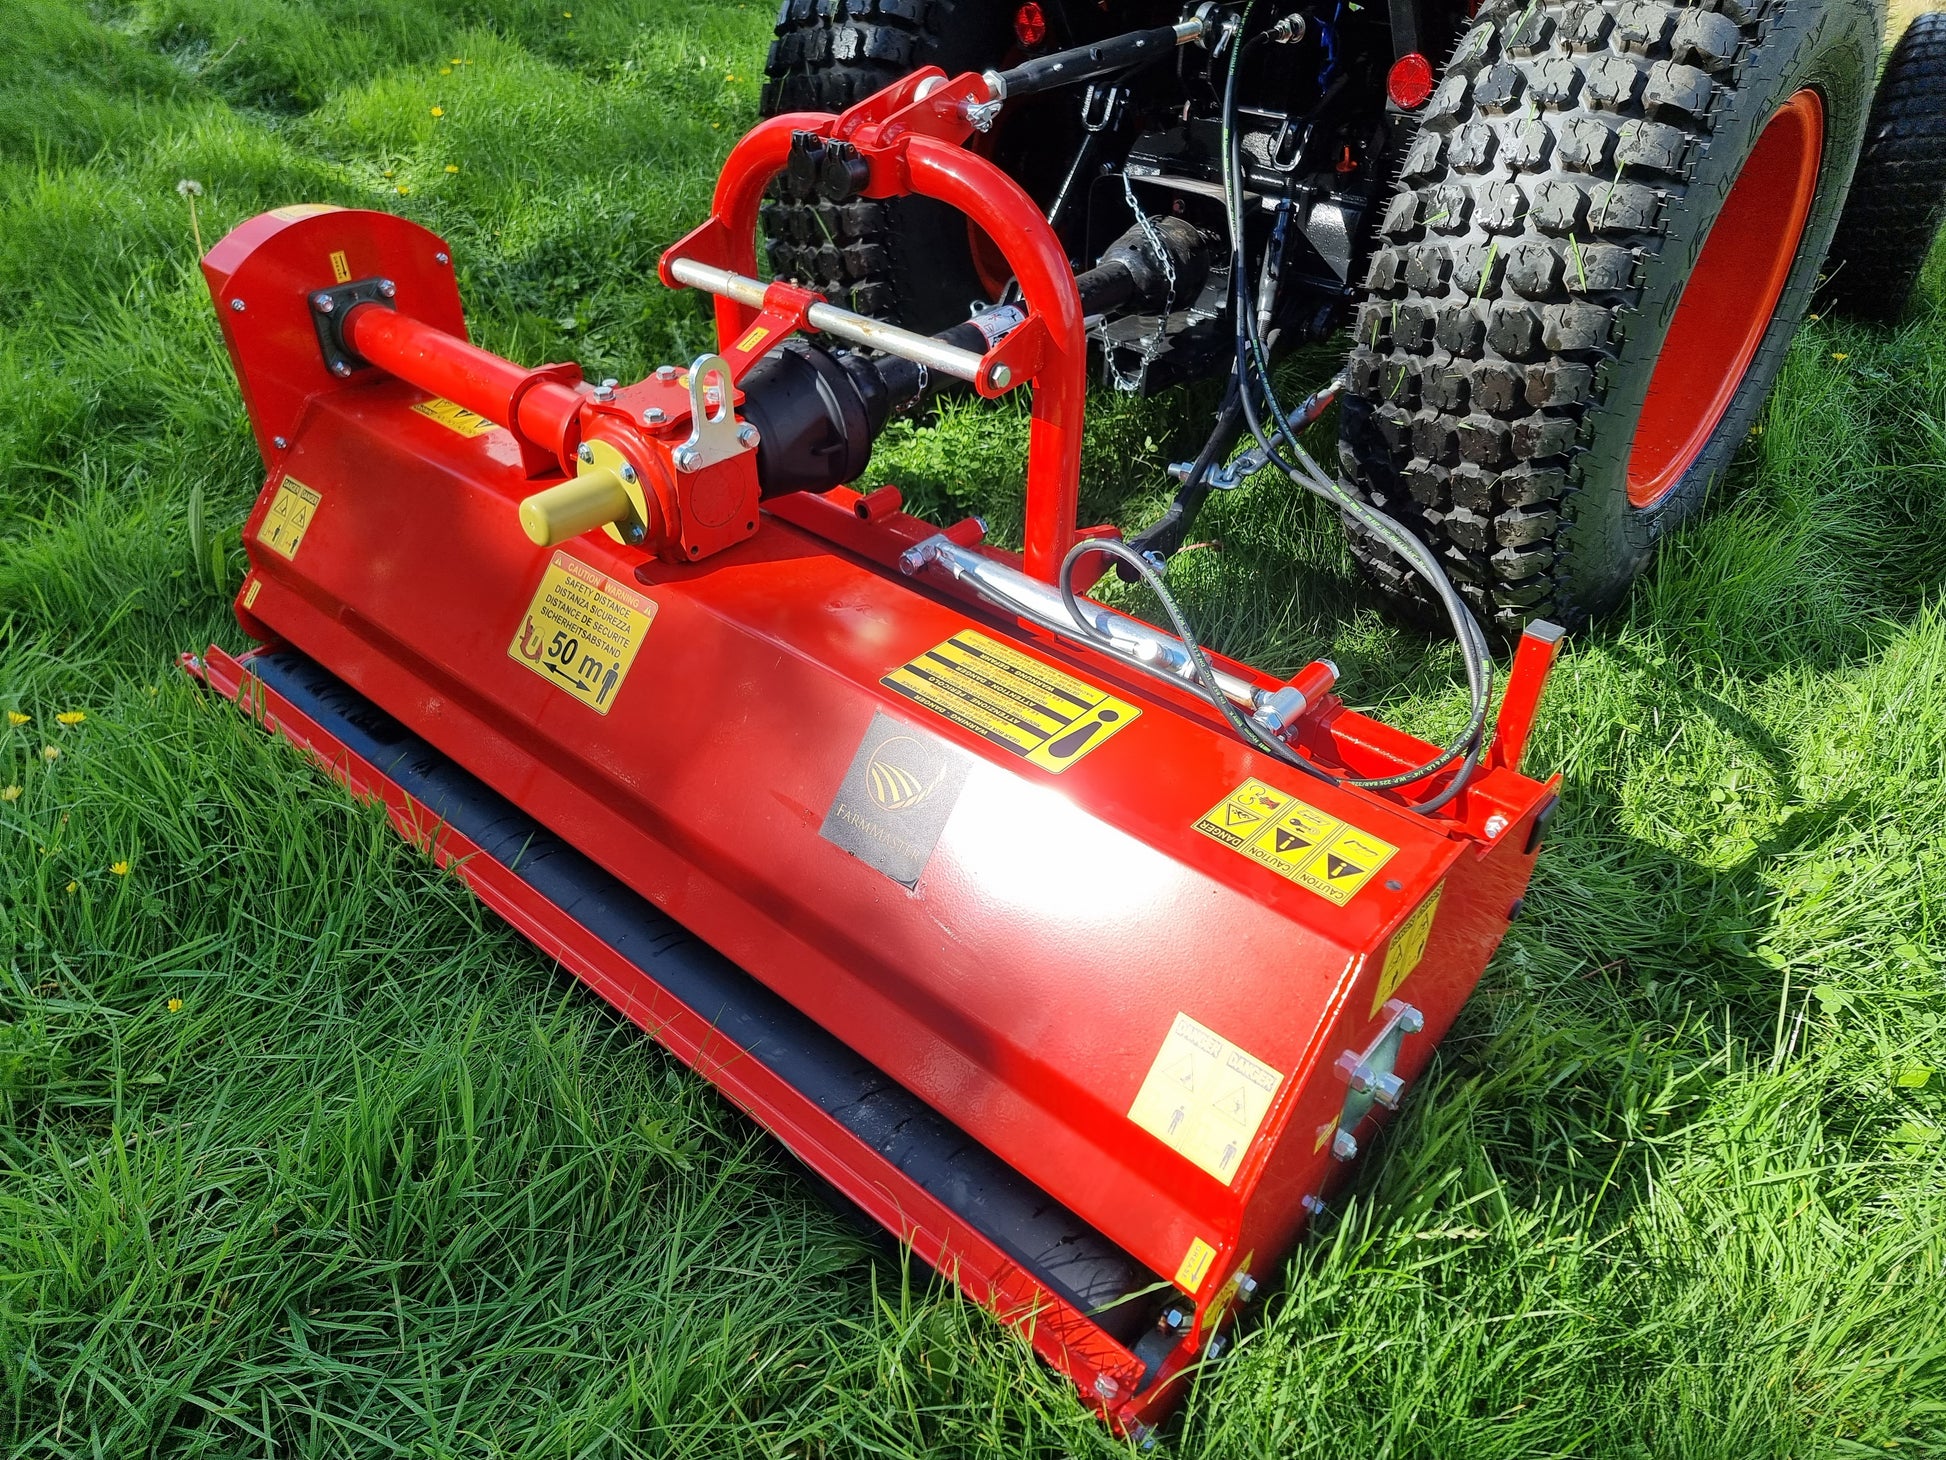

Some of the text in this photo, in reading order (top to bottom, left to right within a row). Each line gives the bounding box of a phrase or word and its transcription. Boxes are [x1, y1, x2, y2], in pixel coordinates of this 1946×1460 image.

[565, 576, 631, 619] SAFETY DISTANCE
[568, 563, 640, 608] CAUTION WARNING
[545, 594, 630, 649] DISTANCE DE SECURITE
[554, 584, 631, 635] DISTANZA SICUREZZA
[540, 606, 621, 659] SICHERHEITSABSTAND
[547, 630, 603, 683] 50 m
[978, 653, 1011, 669] GEFAHR
[926, 675, 967, 696] PERICOLO
[954, 665, 987, 683] DANGER
[1013, 670, 1056, 691] WARNUNG
[912, 694, 947, 713] DANGER
[990, 683, 1036, 707] ATTENTION
[948, 713, 989, 735] WARNING
[969, 697, 1021, 724] ATTENZIONE
[835, 803, 921, 861] FARMMASTER
[1199, 821, 1242, 847] DANGER
[1248, 847, 1291, 872] CAUTION
[1299, 873, 1344, 900] CAUTION
[1176, 1020, 1222, 1058] DANGER
[1227, 1052, 1277, 1091] DANGER
